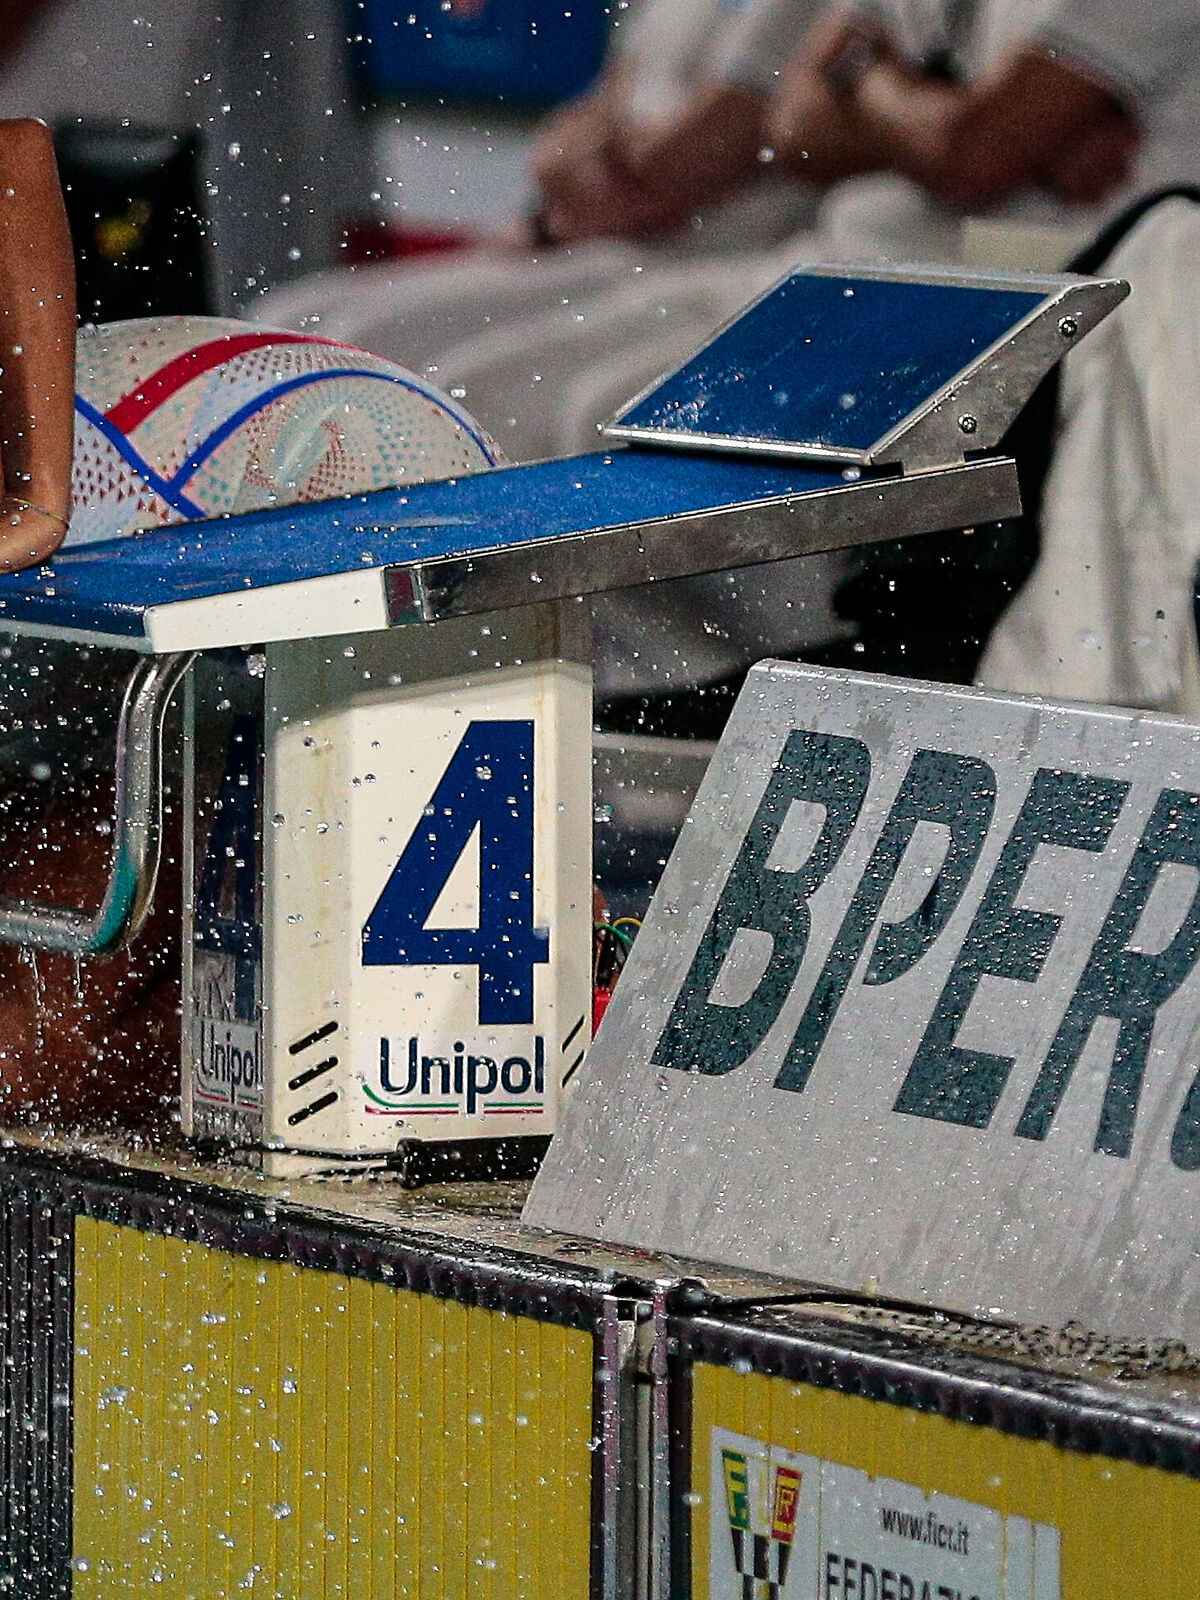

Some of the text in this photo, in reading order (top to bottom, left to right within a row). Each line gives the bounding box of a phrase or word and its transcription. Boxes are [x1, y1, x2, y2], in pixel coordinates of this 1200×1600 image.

[361, 719, 550, 1025] 4
[650, 729, 1200, 1172] BPER
[201, 1020, 259, 1104] Unipol
[379, 1035, 545, 1115] Unipol
